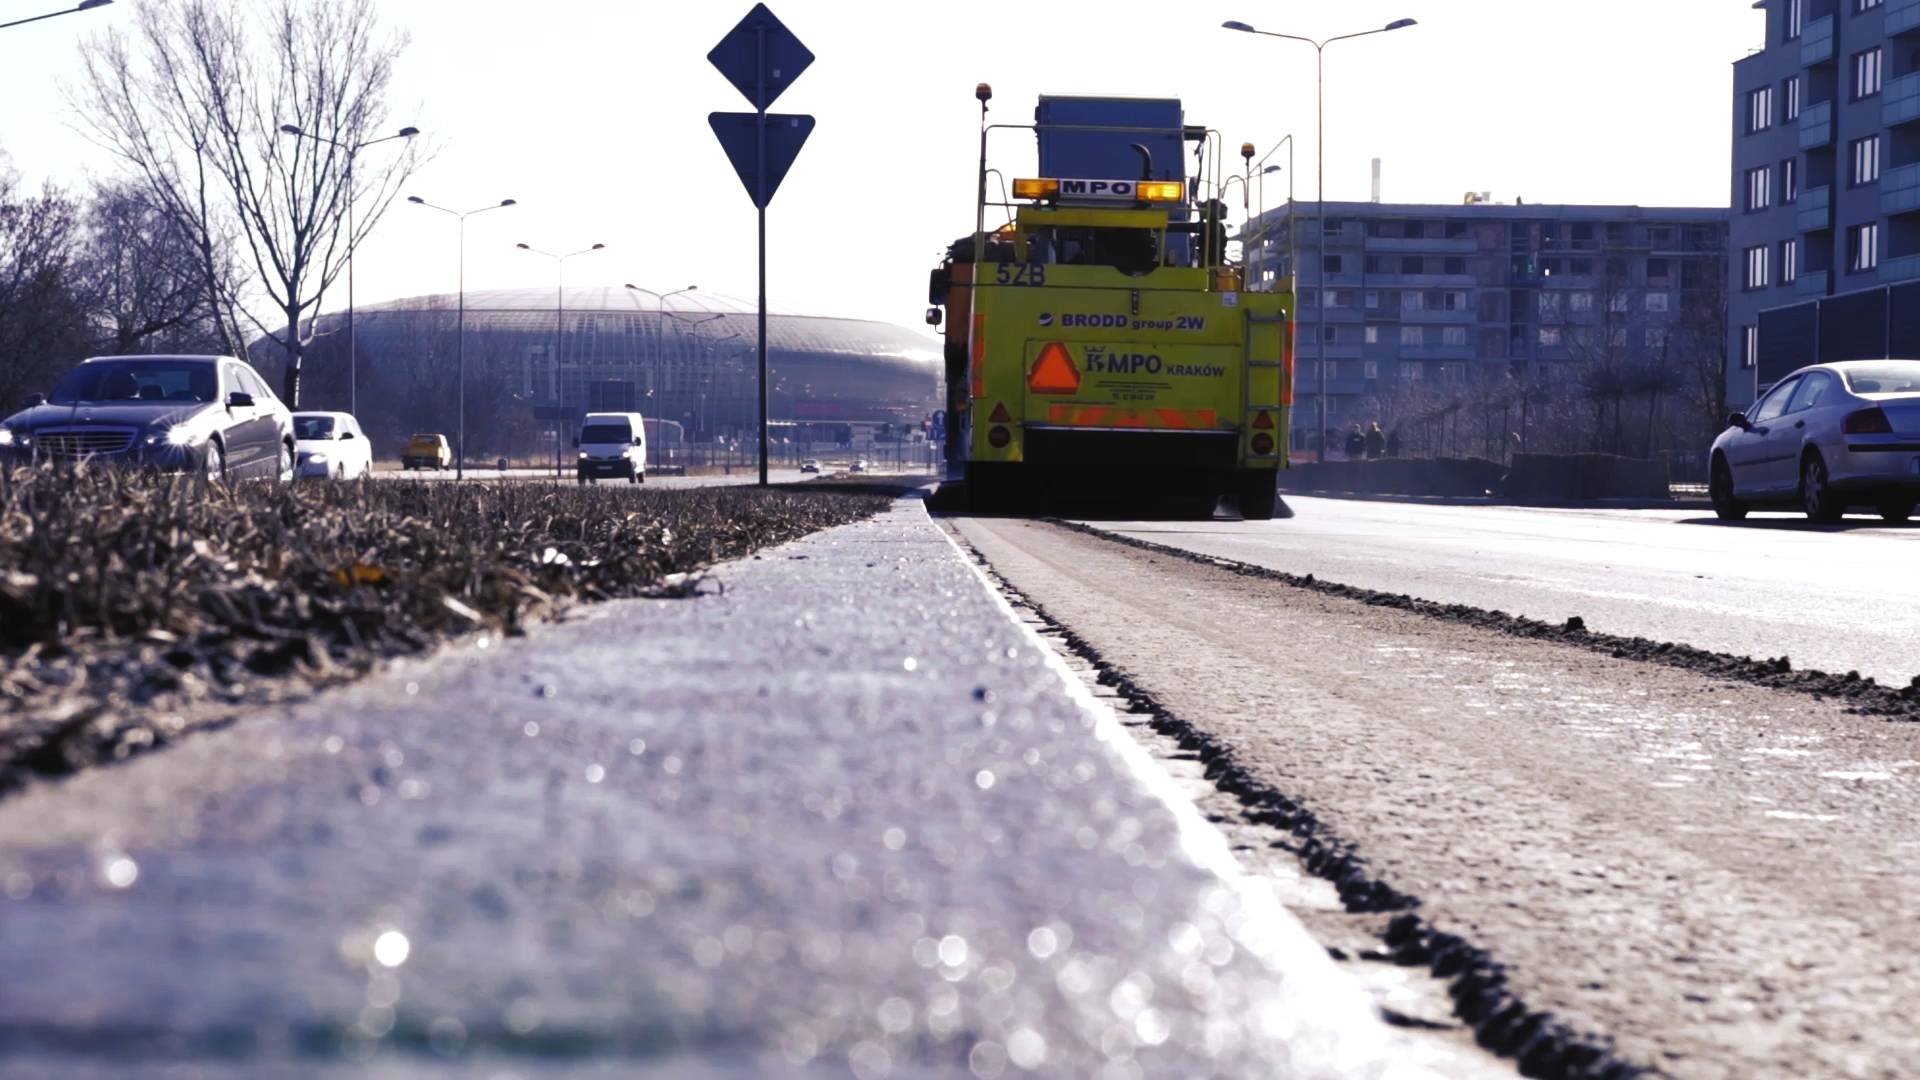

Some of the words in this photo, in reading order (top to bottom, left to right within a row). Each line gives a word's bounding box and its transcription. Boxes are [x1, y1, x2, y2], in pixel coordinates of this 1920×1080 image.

[1062, 181, 1131, 195] MPO
[996, 263, 1045, 286] 5ZB
[1061, 313, 1128, 328] BRODD
[1131, 319, 1174, 331] group
[1176, 316, 1205, 330] 2W
[1166, 364, 1226, 377] KRAKÓW
